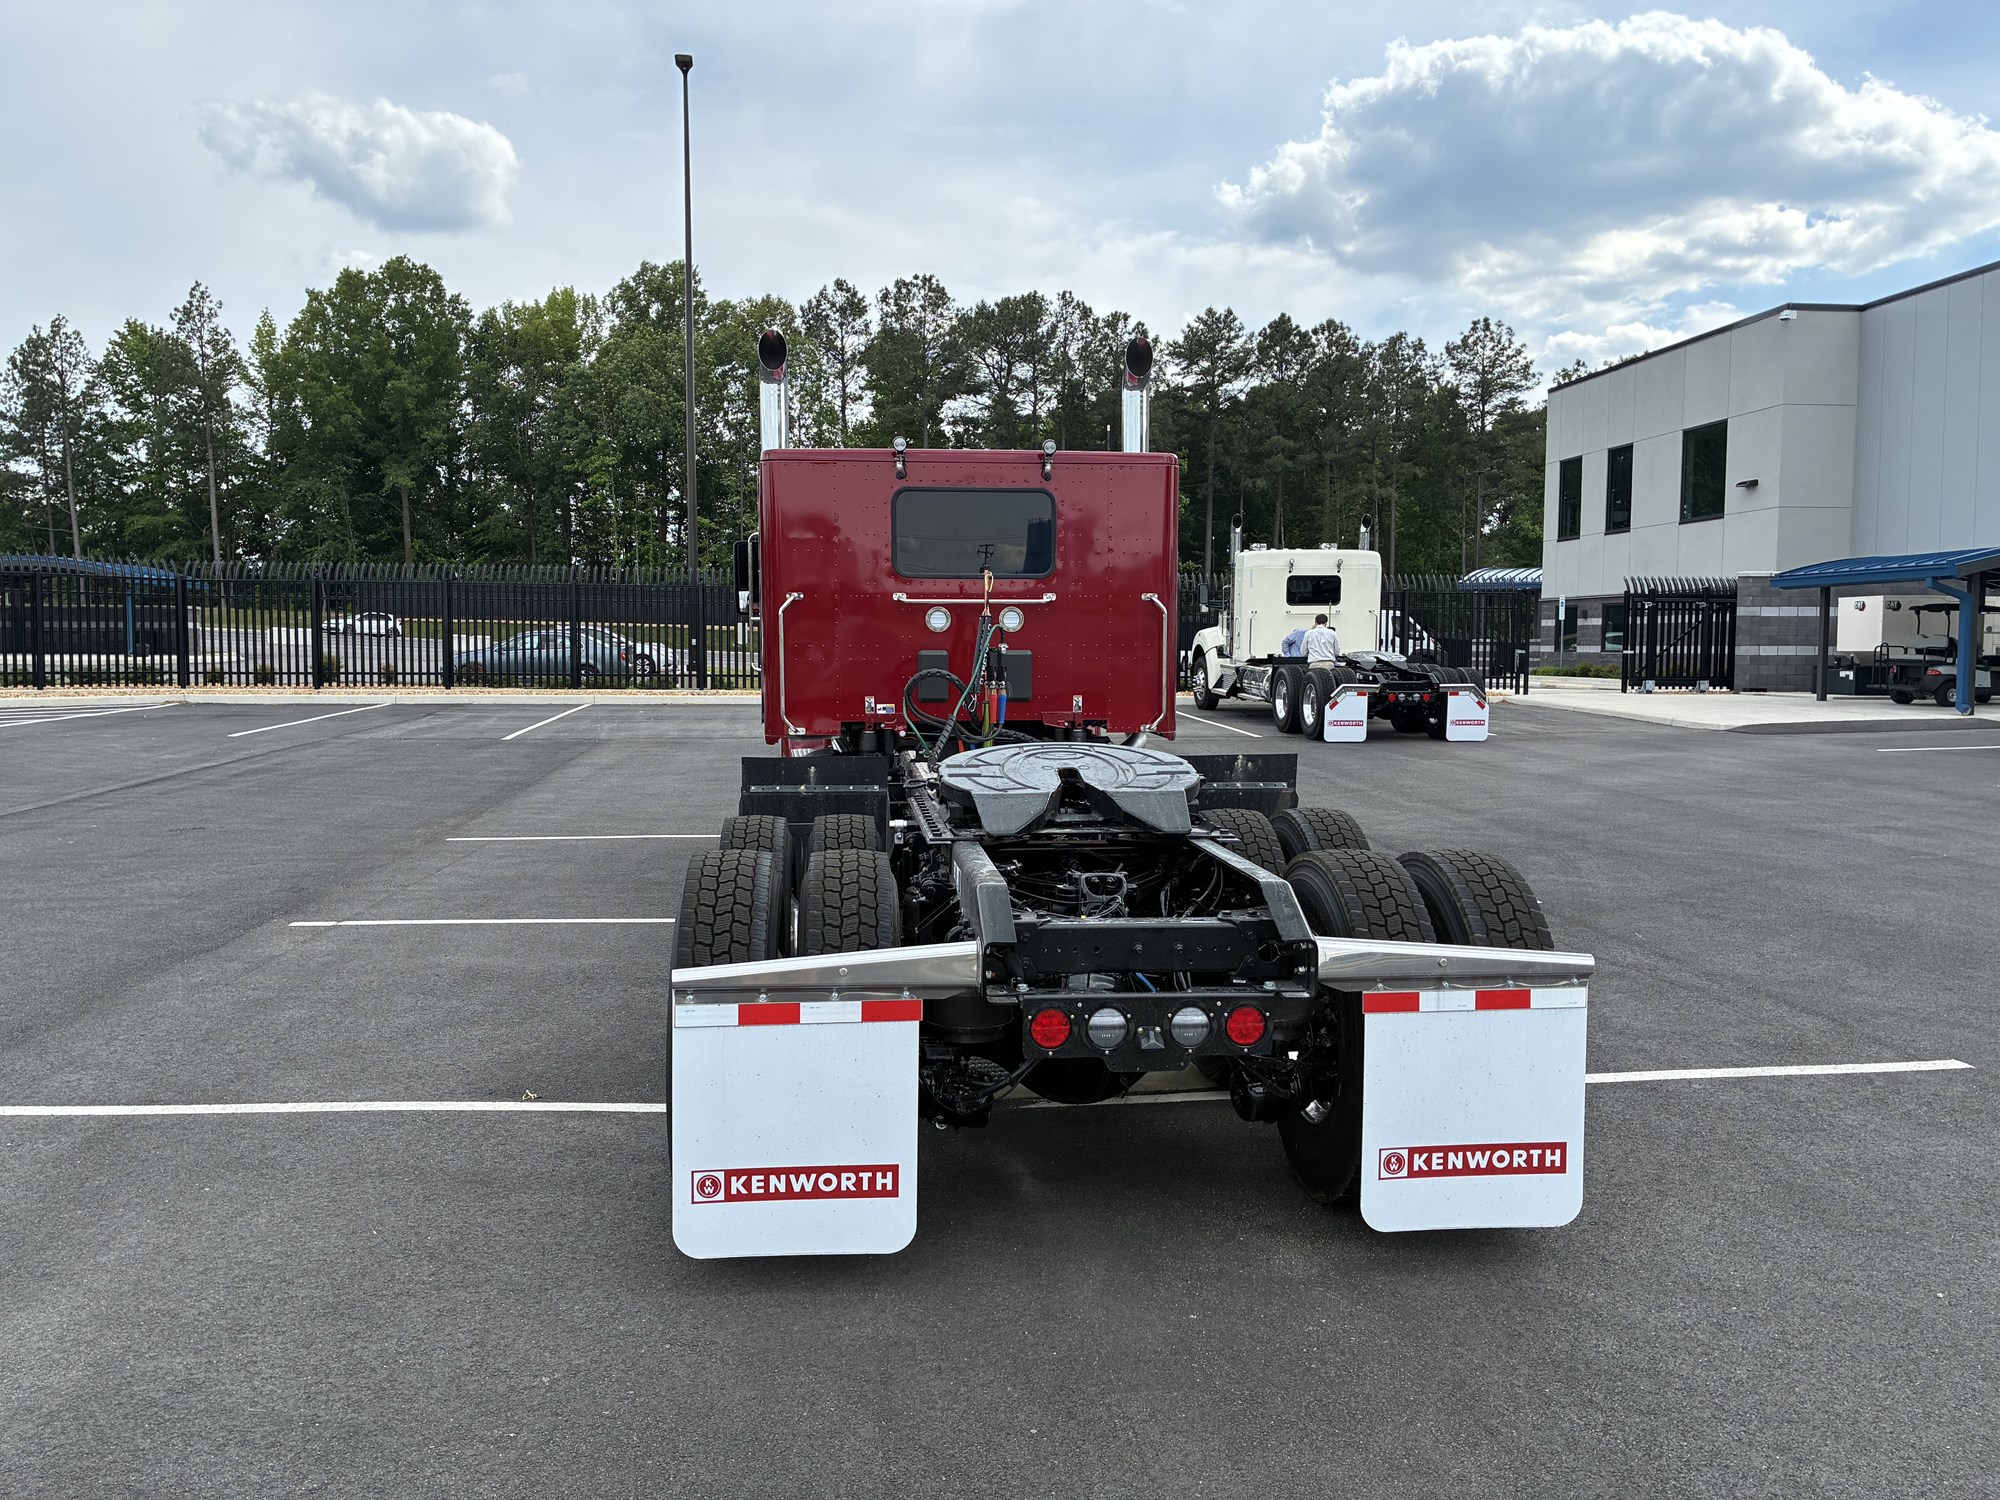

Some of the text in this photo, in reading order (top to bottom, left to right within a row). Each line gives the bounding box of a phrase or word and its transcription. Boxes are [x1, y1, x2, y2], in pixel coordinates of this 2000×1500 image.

[1886, 601, 1898, 609] CAT
[1413, 1149, 1561, 1172] KENWORTH
[730, 1172, 893, 1195] KENWORTH
